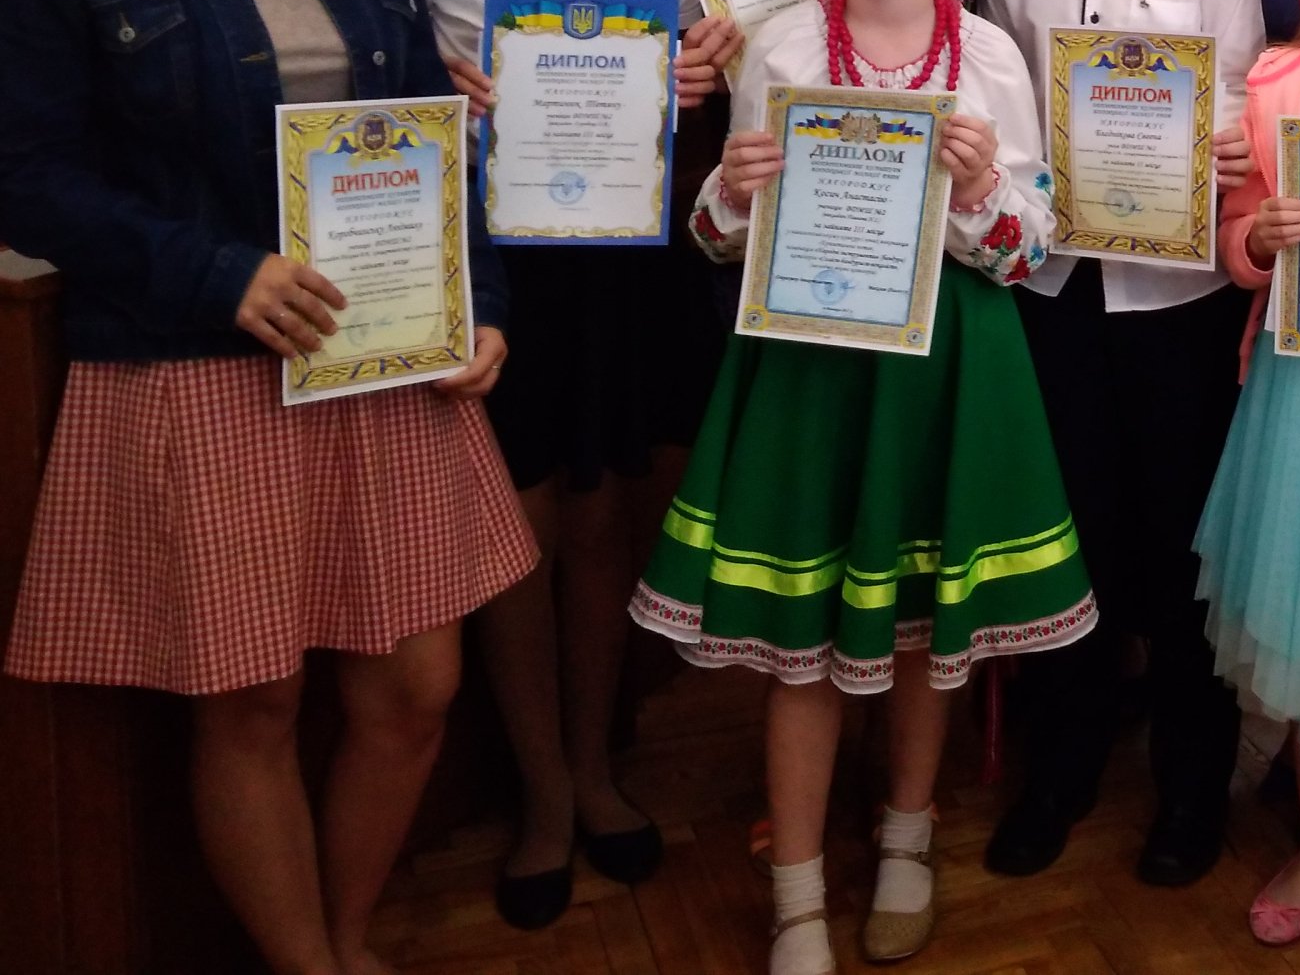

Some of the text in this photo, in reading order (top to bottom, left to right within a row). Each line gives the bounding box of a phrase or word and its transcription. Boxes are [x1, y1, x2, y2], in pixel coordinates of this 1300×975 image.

[535, 54, 626, 69] ДИПЛОМ
[1090, 85, 1172, 104] ДИПЛОМ
[809, 144, 905, 163] ДИПЛОМ
[331, 169, 420, 195] ДИПЛОМ
